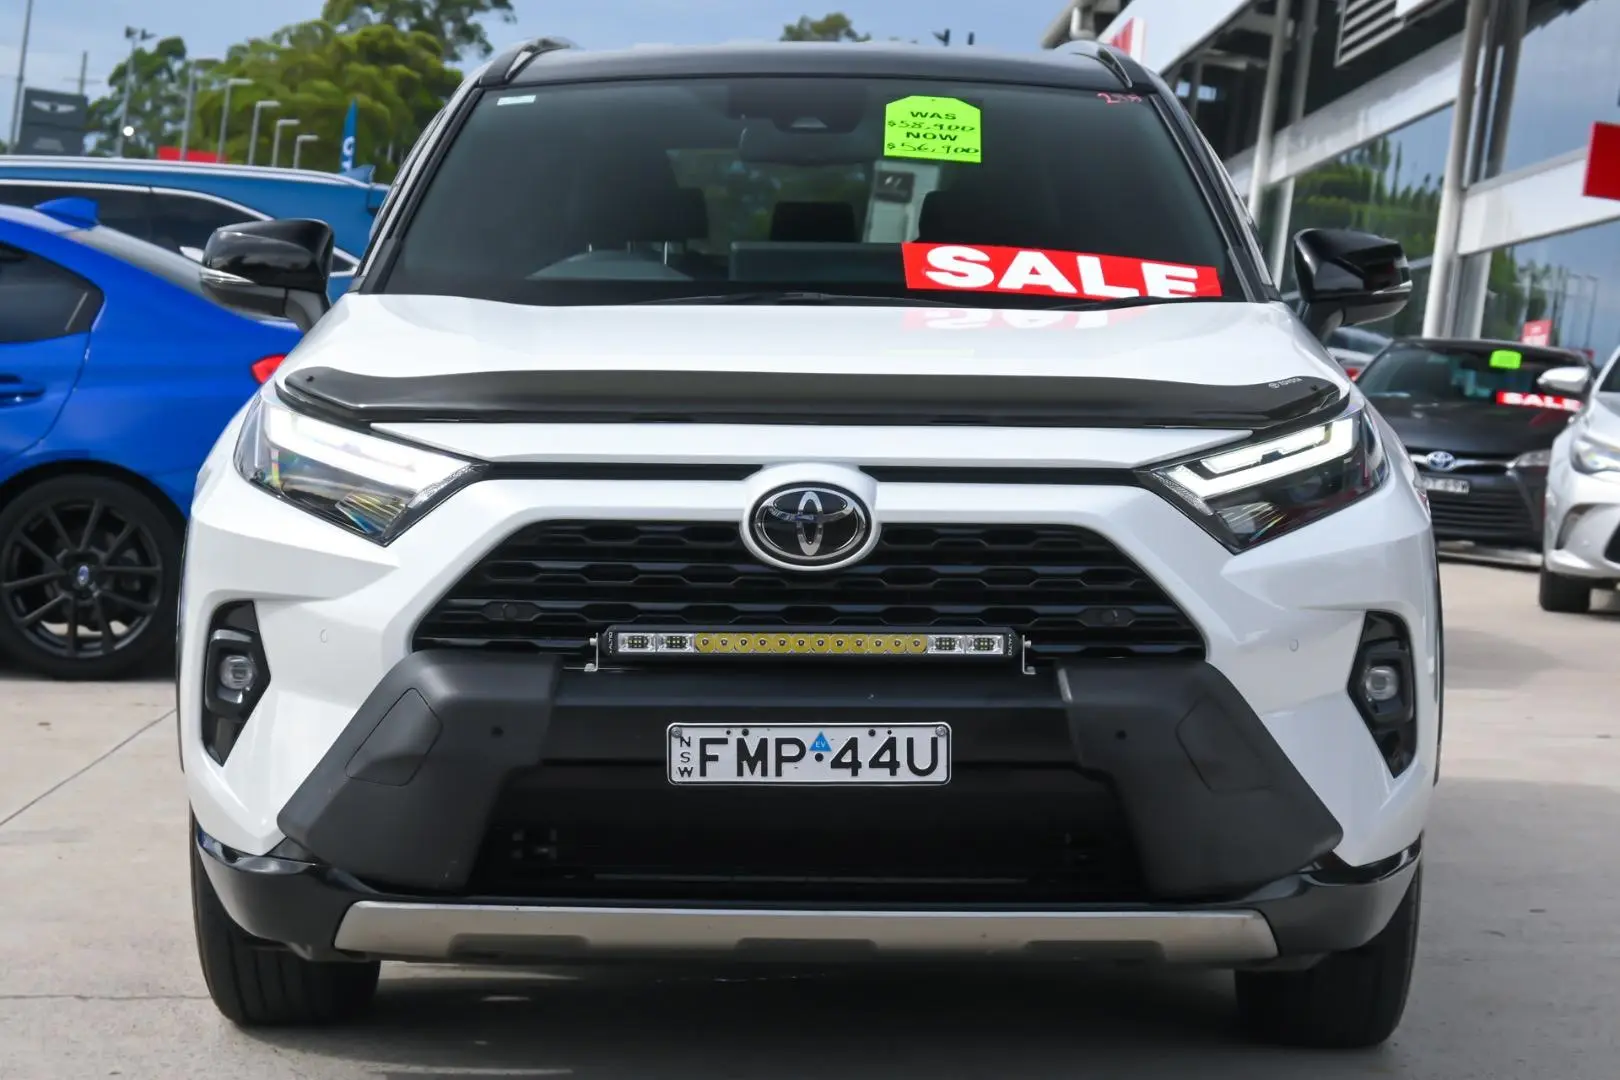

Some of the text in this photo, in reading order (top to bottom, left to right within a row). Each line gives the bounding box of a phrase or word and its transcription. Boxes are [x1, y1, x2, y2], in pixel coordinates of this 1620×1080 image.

[910, 111, 957, 120] WAS
[906, 131, 958, 142] NOW
[925, 245, 1199, 298] SALE
[1503, 391, 1582, 412] SALE
[678, 735, 694, 778] NSW
[699, 736, 939, 777] FMP 44U
